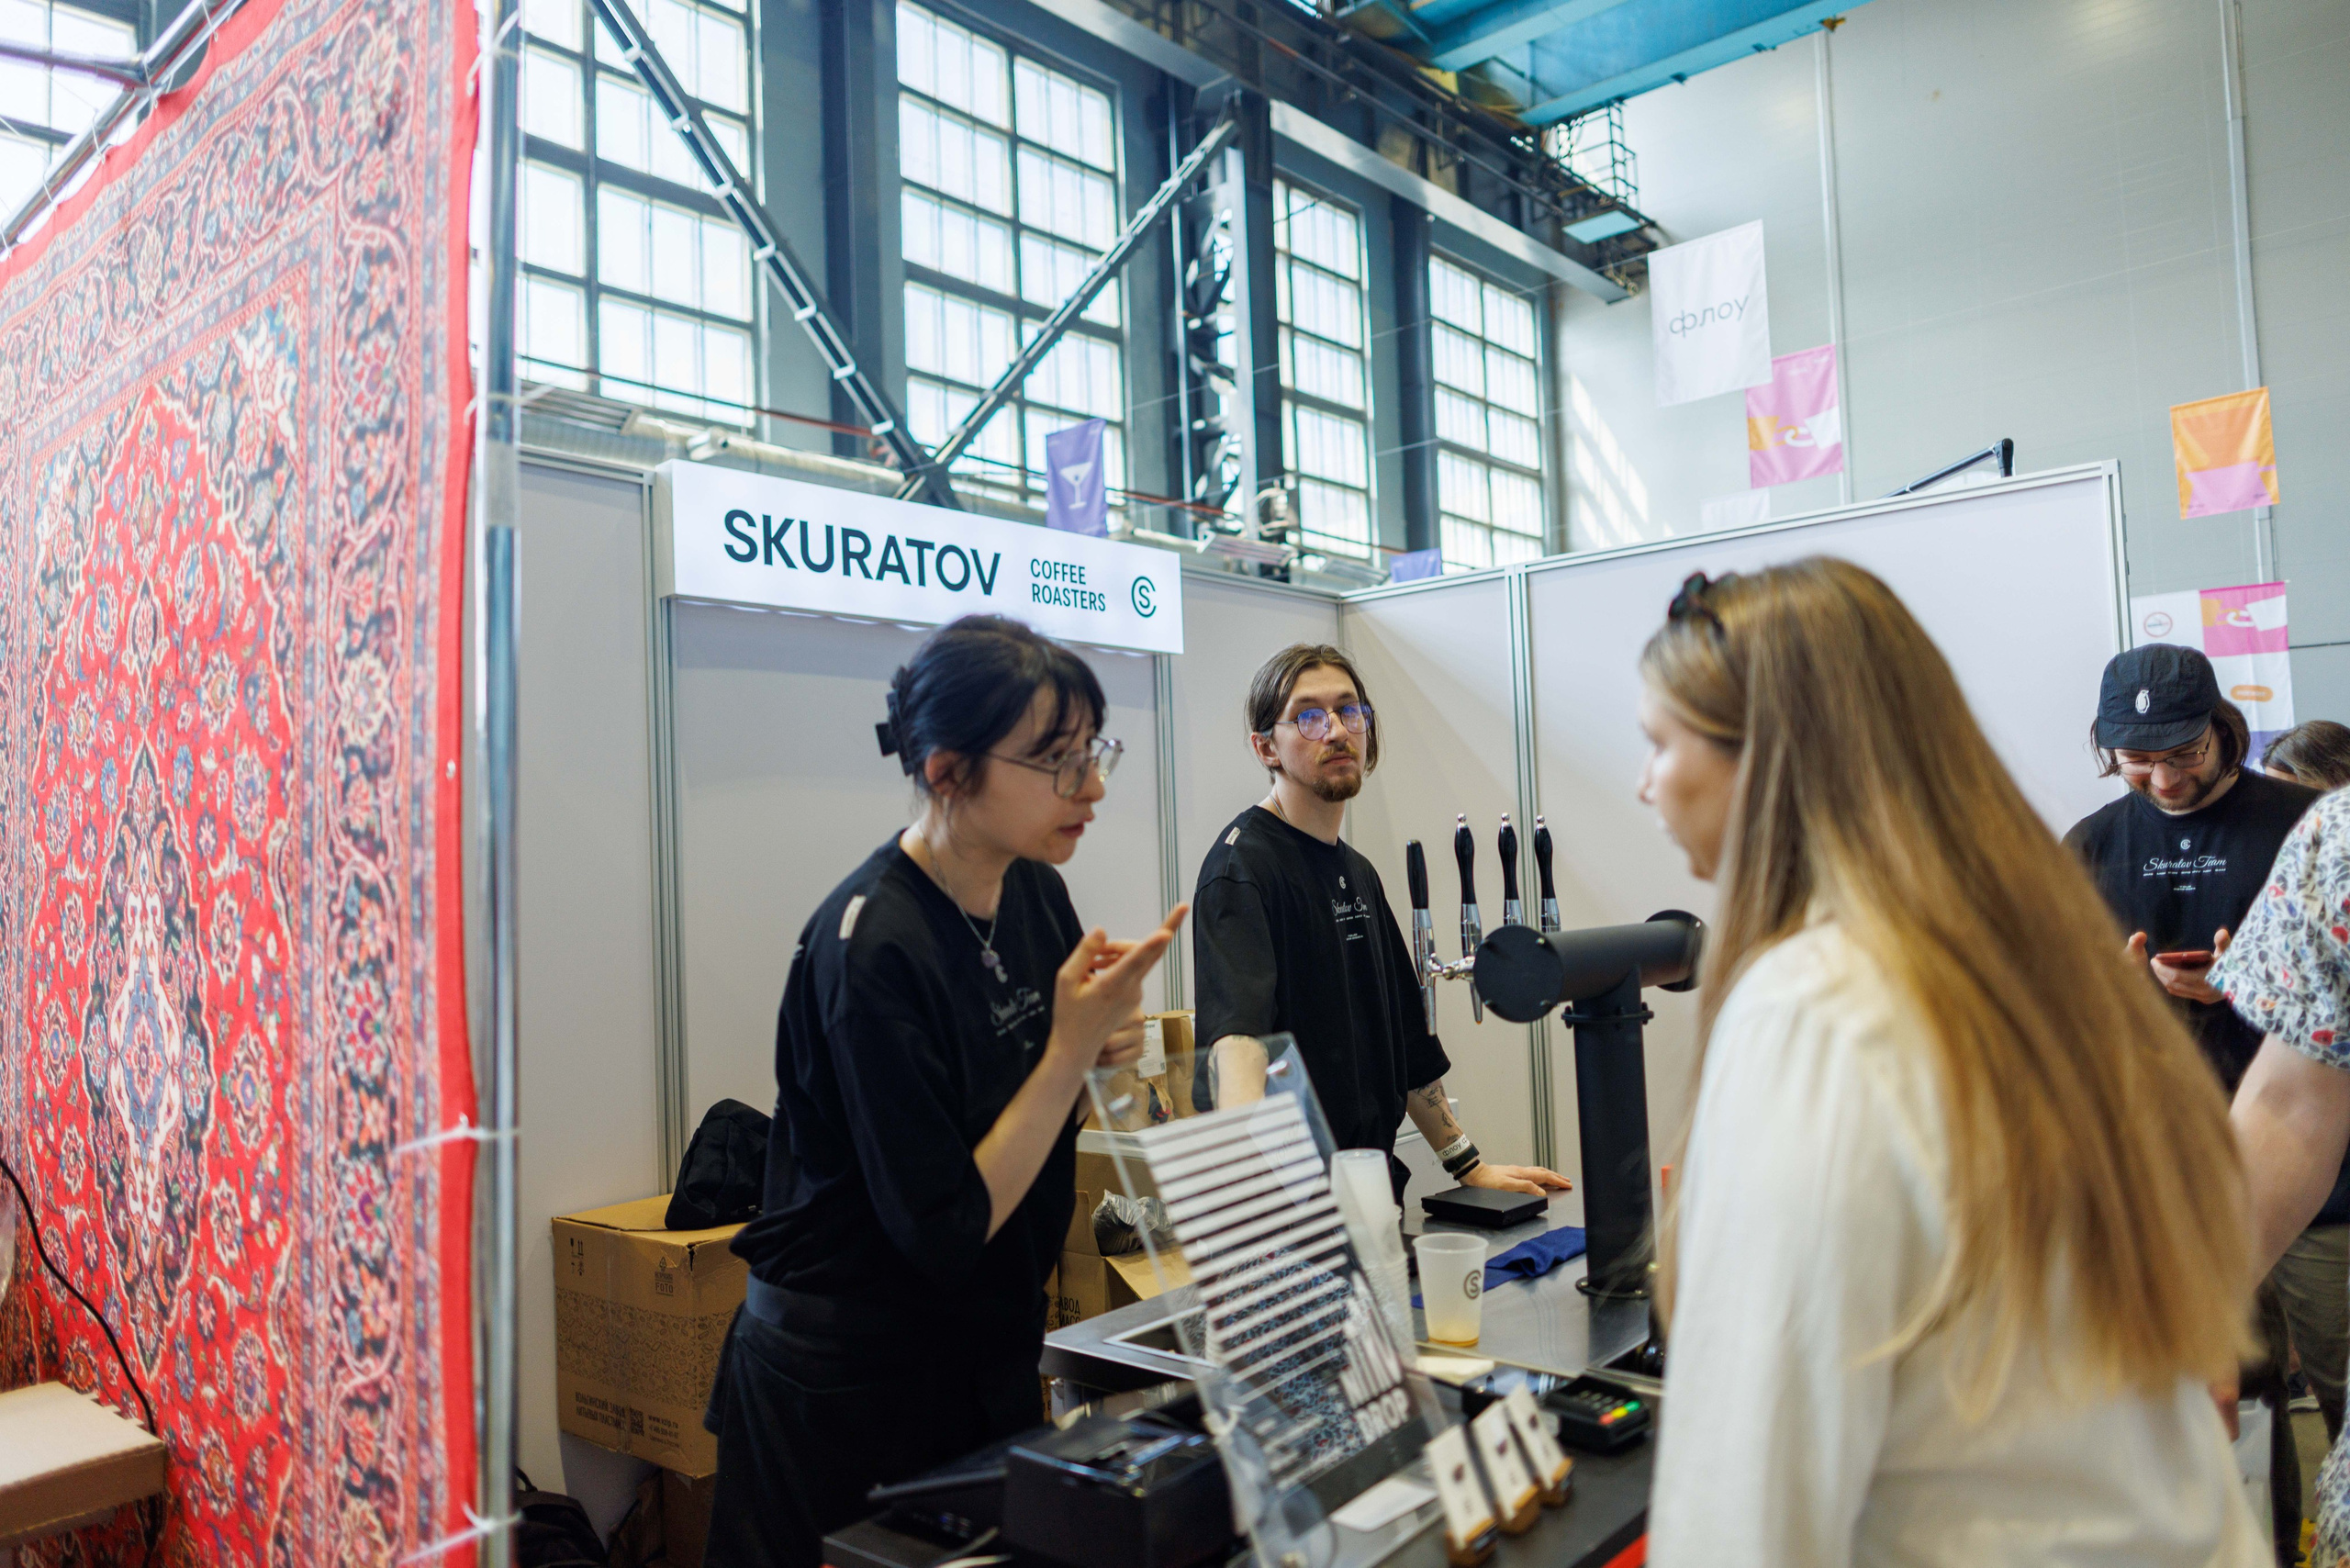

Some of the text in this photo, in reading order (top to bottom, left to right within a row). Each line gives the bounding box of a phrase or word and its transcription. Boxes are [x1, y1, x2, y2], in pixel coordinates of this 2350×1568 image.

[1669, 294, 1749, 338] флоу
[723, 509, 1001, 596] SKURATOV
[1030, 558, 1087, 585] COFFEE
[1031, 583, 1106, 613] ROASTERS
[2143, 856, 2227, 871] Skuratov Team
[1442, 1142, 1461, 1157] флоу
[1059, 1295, 1080, 1315] АВОД
